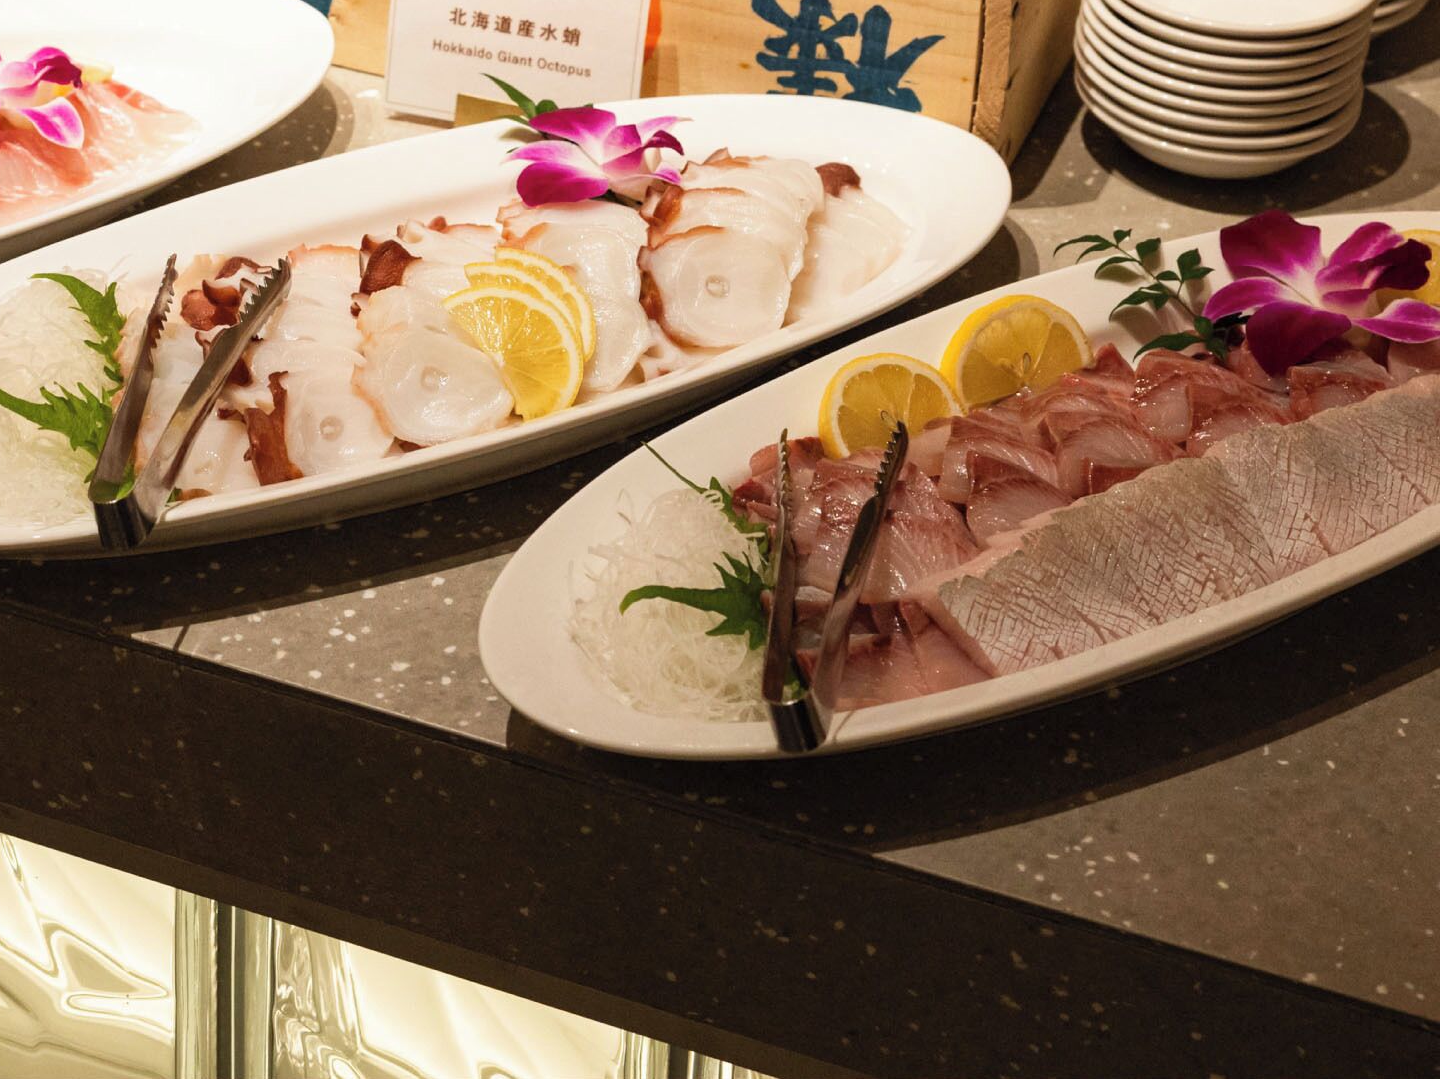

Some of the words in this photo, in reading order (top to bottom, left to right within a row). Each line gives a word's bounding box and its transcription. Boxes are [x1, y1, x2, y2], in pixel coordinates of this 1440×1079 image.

[448, 7, 582, 47] 北海道産水蛸
[431, 39, 493, 61] Hokkaido
[497, 49, 533, 68] Giant
[537, 57, 592, 78] Octopus
